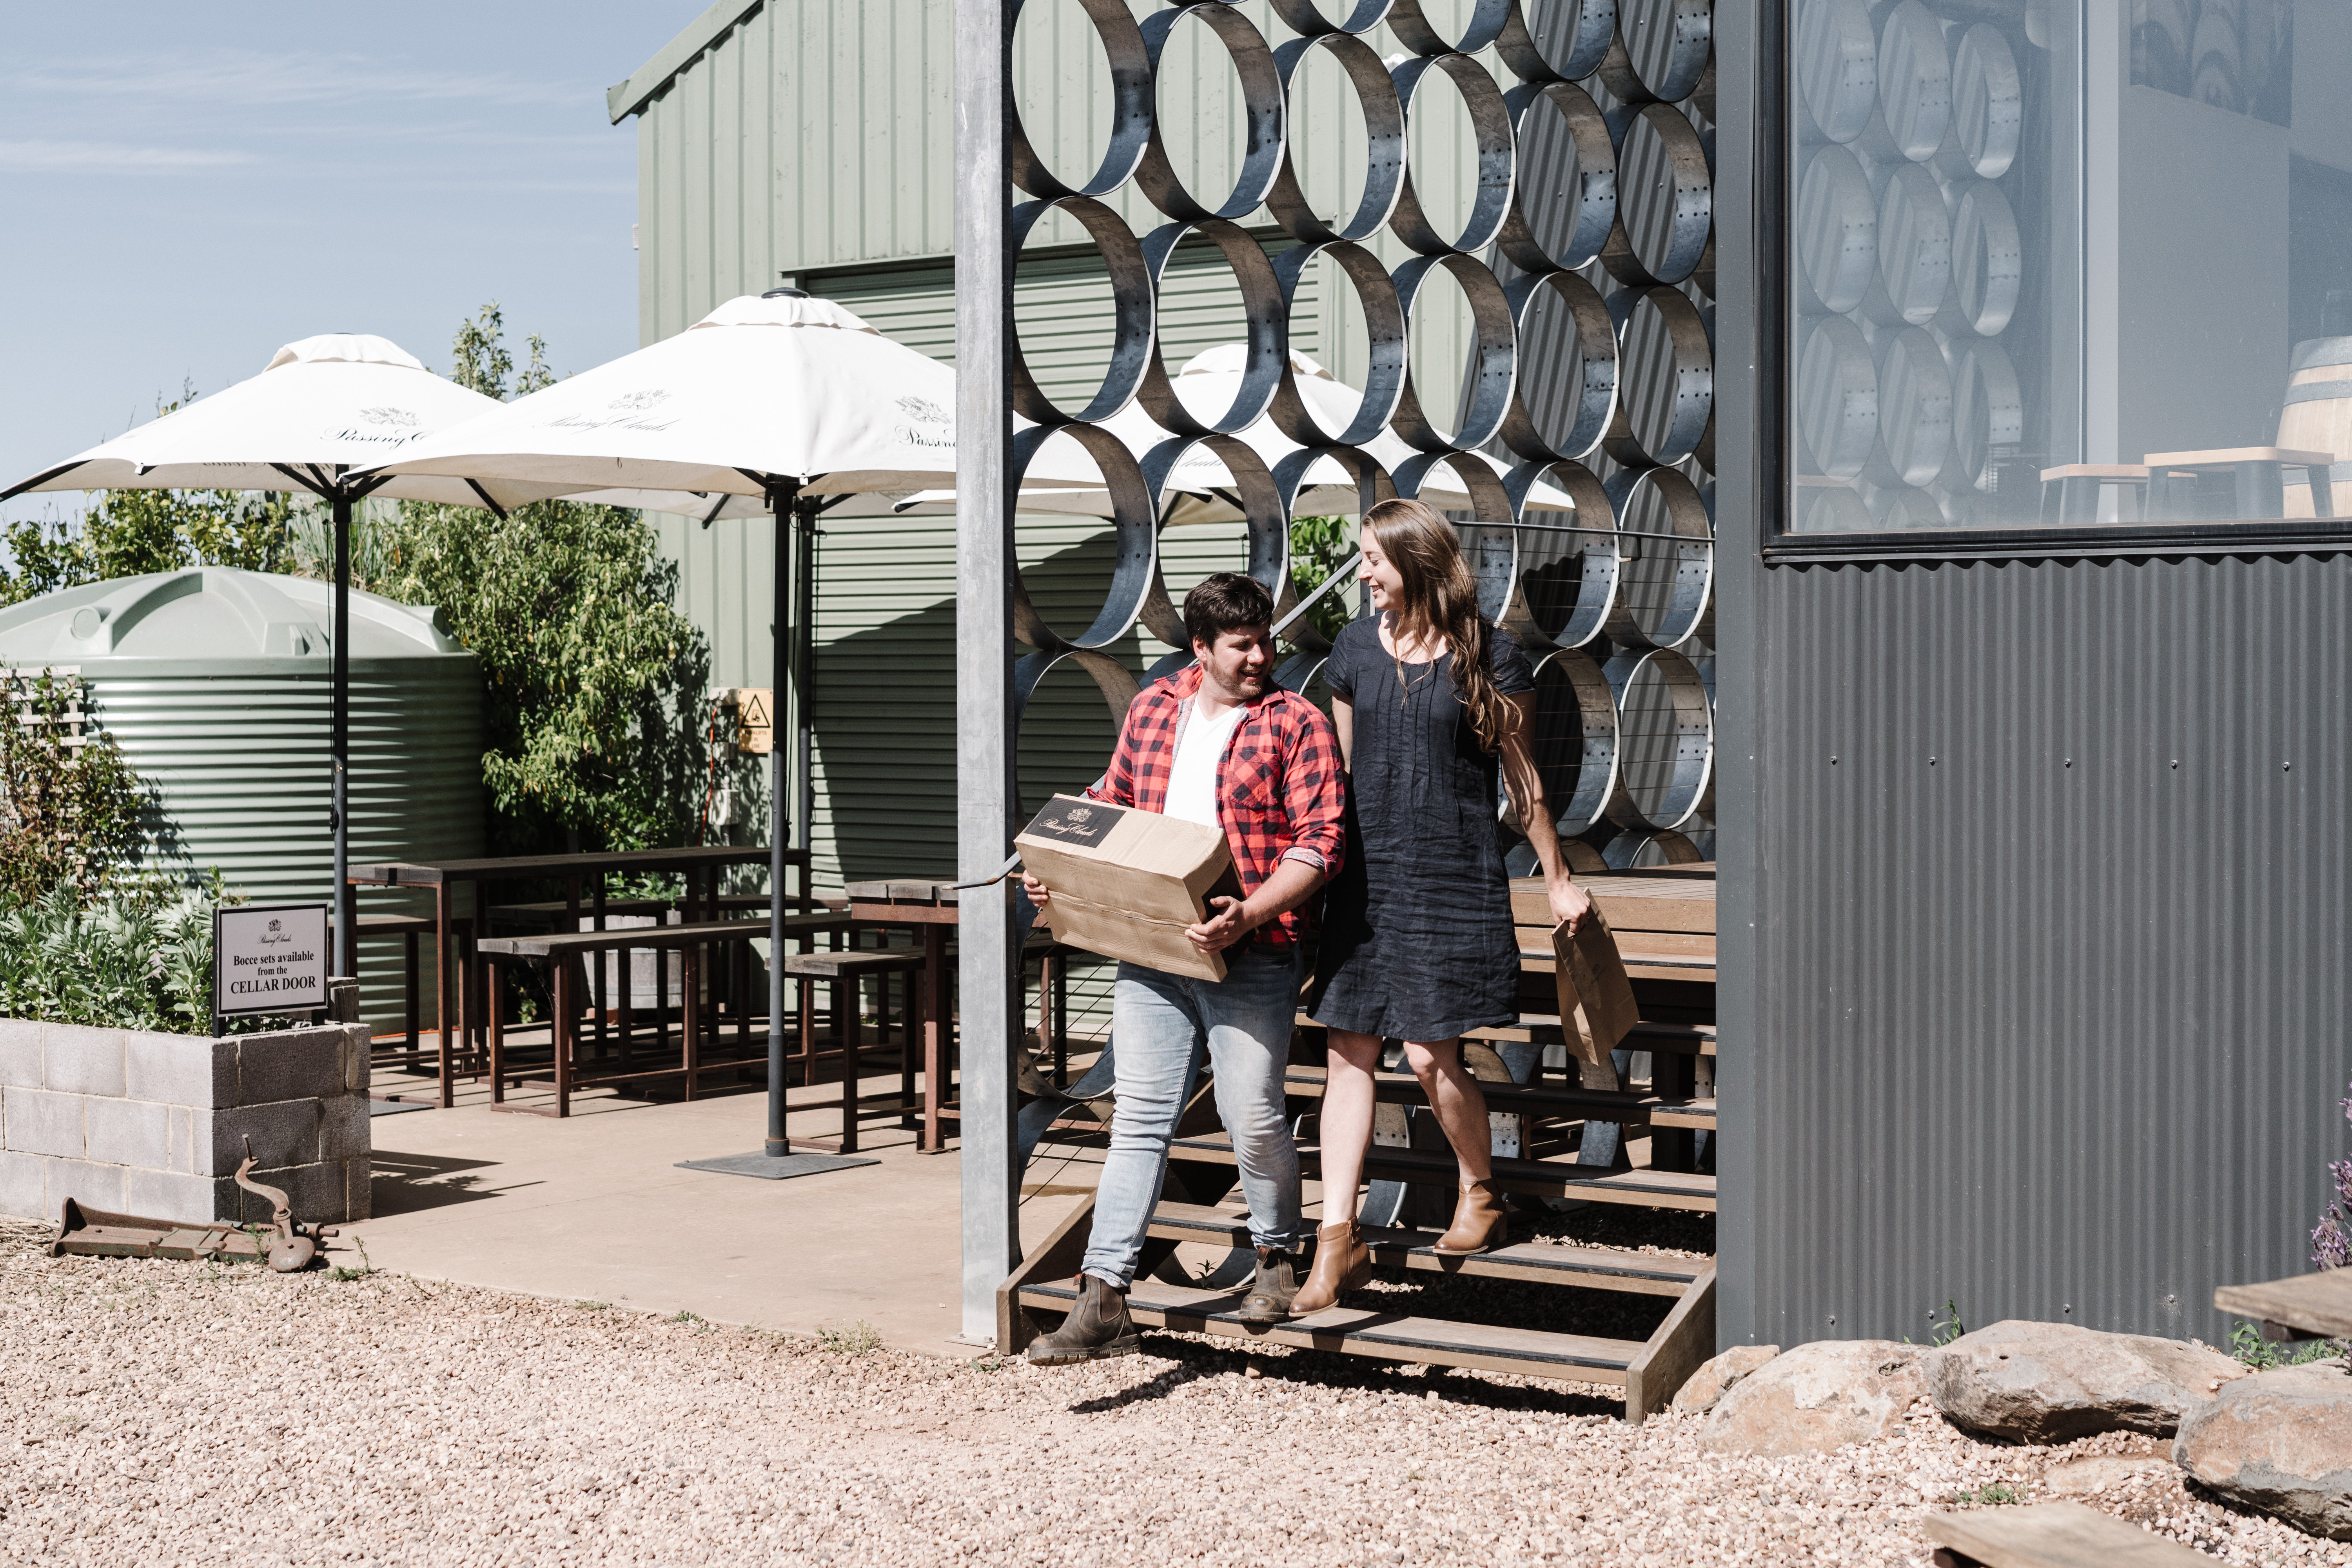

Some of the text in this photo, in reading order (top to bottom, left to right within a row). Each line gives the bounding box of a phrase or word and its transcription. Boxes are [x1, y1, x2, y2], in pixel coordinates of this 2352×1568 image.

[532, 412, 681, 435] Passing Clouds
[320, 426, 406, 450] Passing
[895, 425, 956, 448] Passin
[1179, 452, 1223, 467] louds
[1039, 818, 1098, 836] Passing Clouds
[257, 933, 292, 947] Passing Clouds
[234, 951, 314, 965] Bocce sets available
[258, 965, 287, 976] from the
[230, 976, 316, 994] CELLAR DOOR
